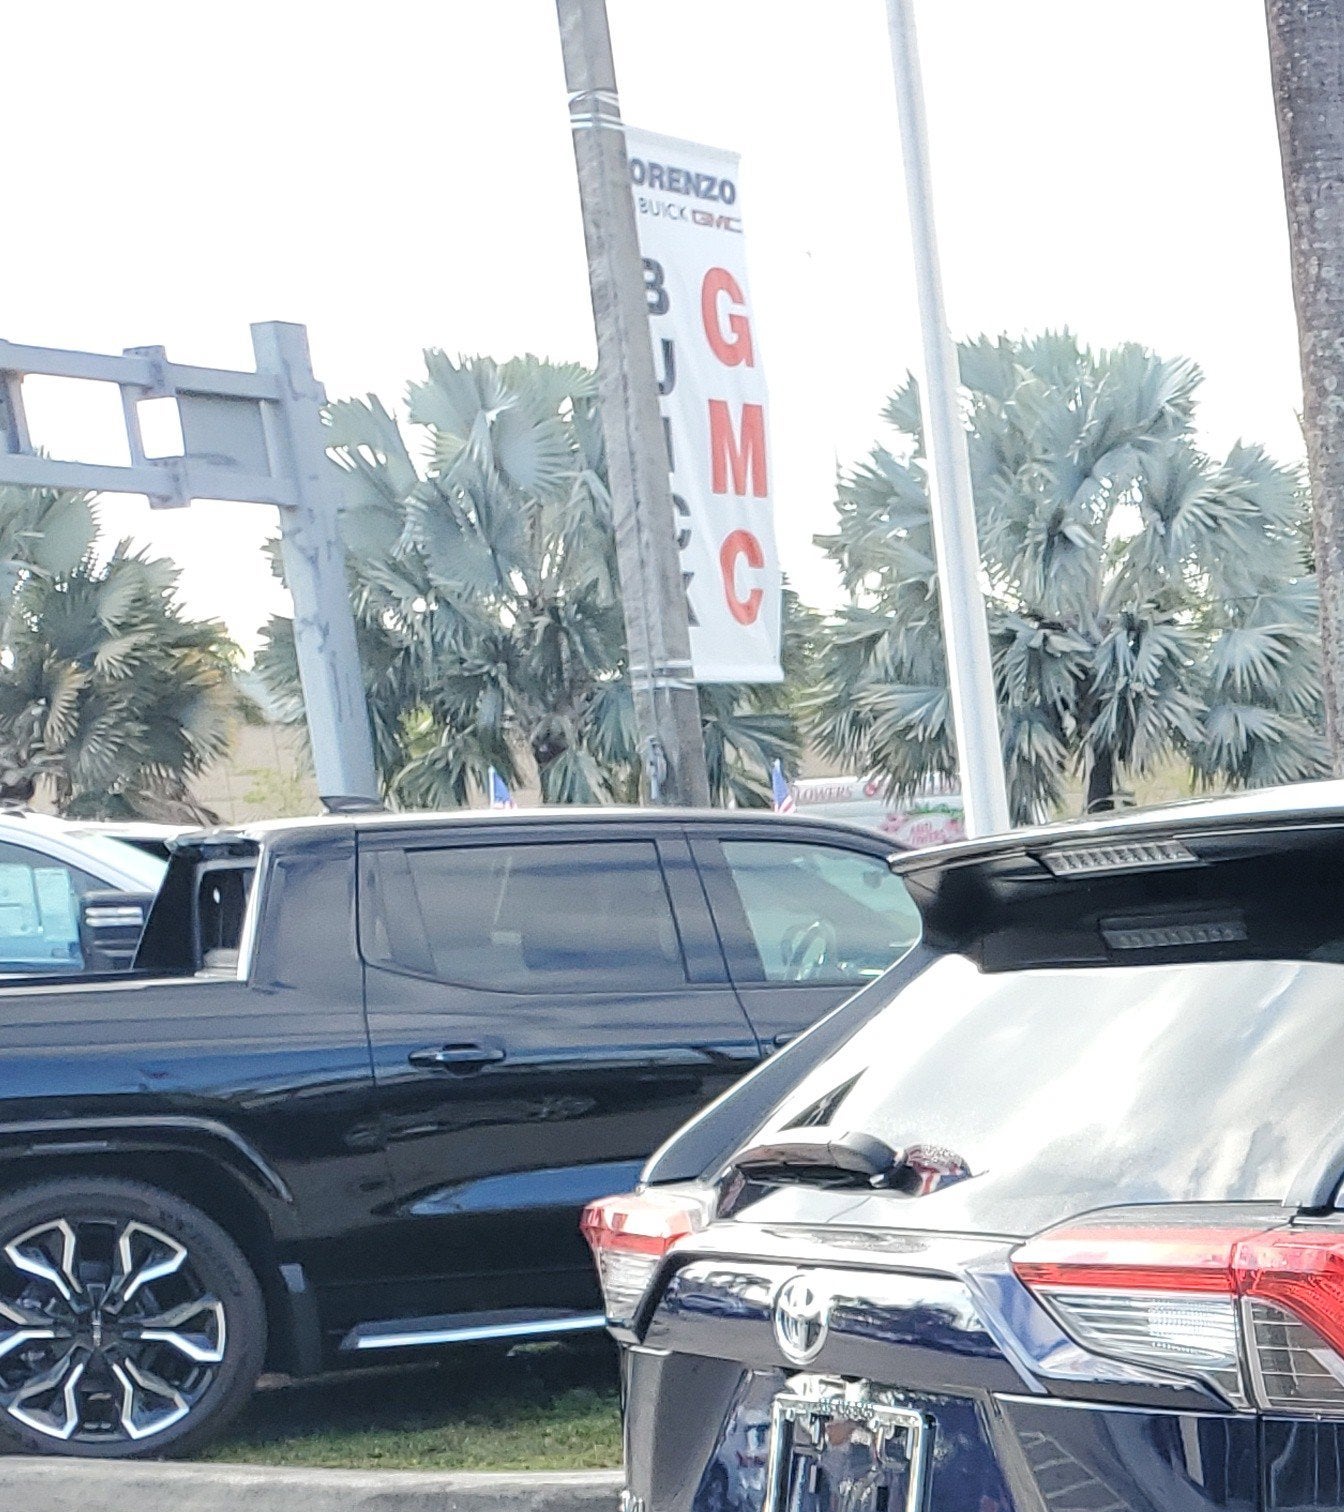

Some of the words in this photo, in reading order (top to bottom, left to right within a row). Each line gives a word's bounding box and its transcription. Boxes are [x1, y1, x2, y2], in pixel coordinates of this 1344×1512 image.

[630, 158, 736, 205] ORENZO
[639, 197, 689, 221] BUICK
[692, 209, 743, 234] GMC
[701, 267, 768, 626] GMC
[794, 786, 851, 800] LOWERS
